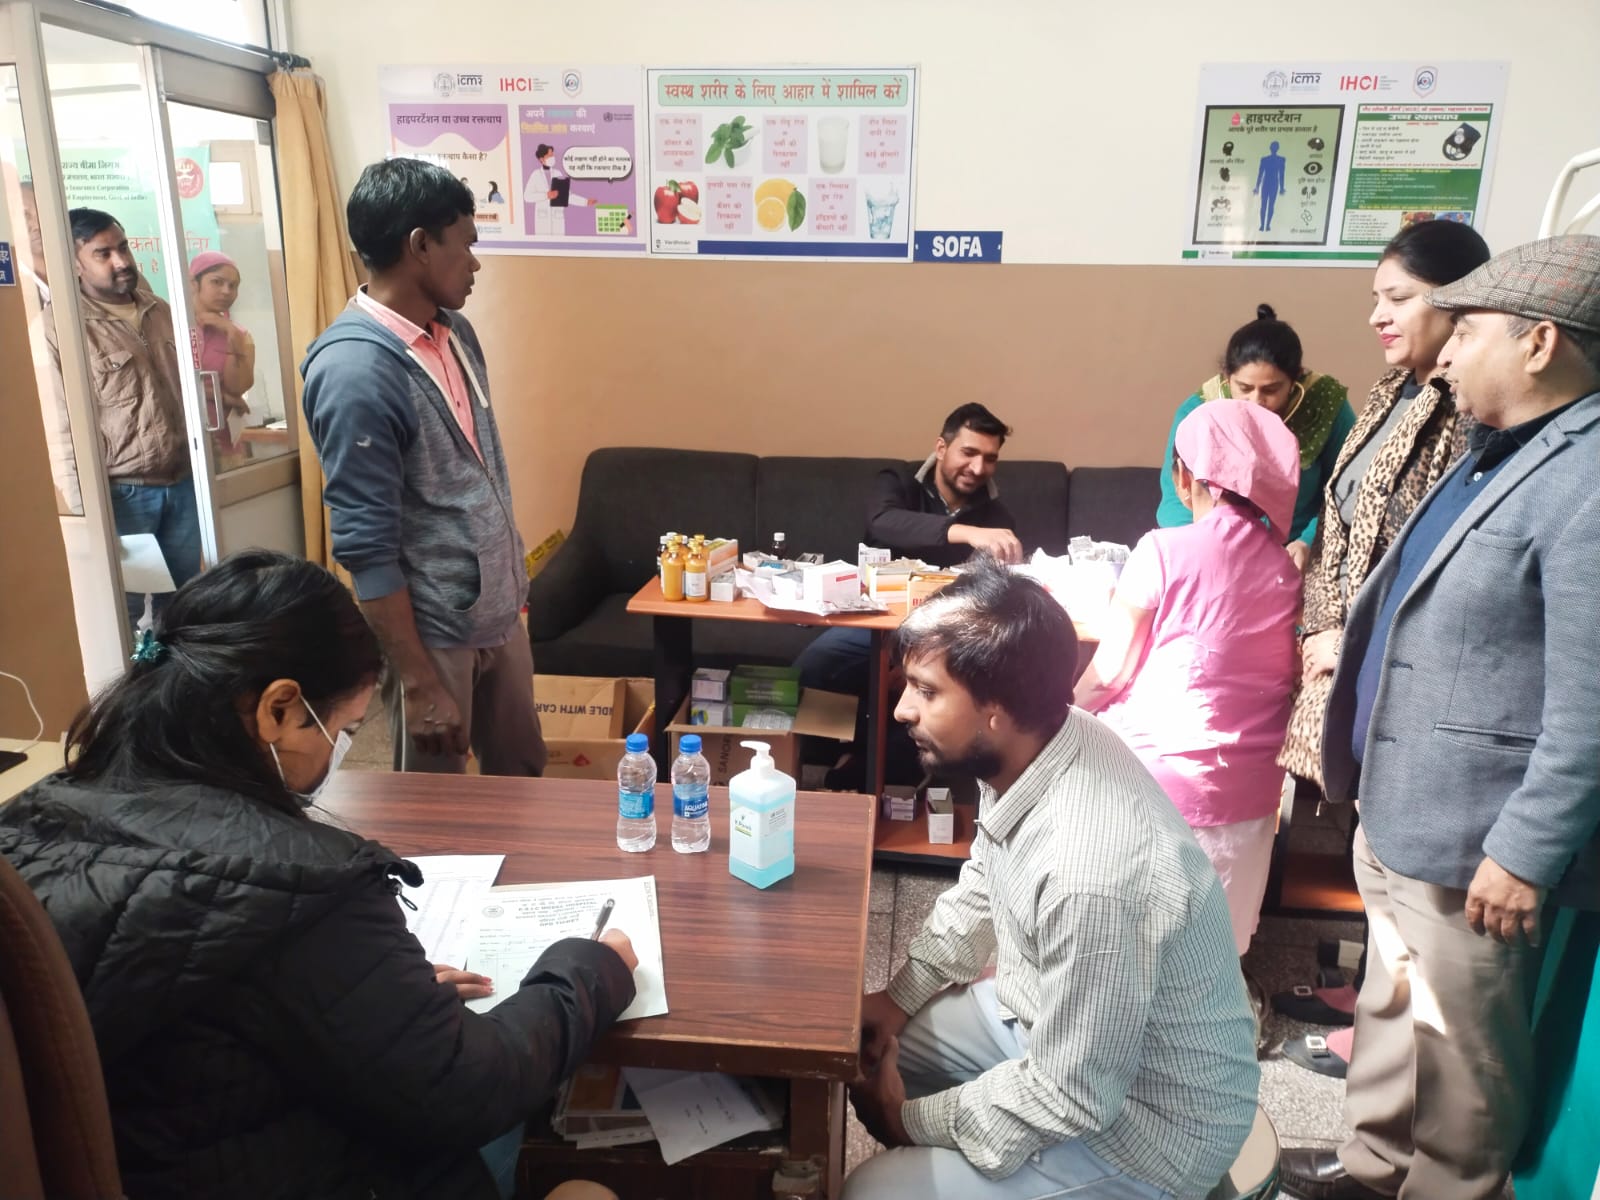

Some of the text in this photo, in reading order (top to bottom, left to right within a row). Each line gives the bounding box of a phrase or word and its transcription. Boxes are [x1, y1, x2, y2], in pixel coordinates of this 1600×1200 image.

[500, 77, 532, 91] IHCI
[1340, 75, 1378, 91] IHCI
[664, 78, 903, 104] स्वस्थ शरीर के लिए आहार में शामिल करें
[396, 113, 440, 125] हाइपरटेंशन
[1246, 110, 1302, 124] हाइपरटेंशन
[932, 236, 983, 258] SOFA
[536, 703, 557, 713] CAR
[560, 704, 586, 715] WITH
